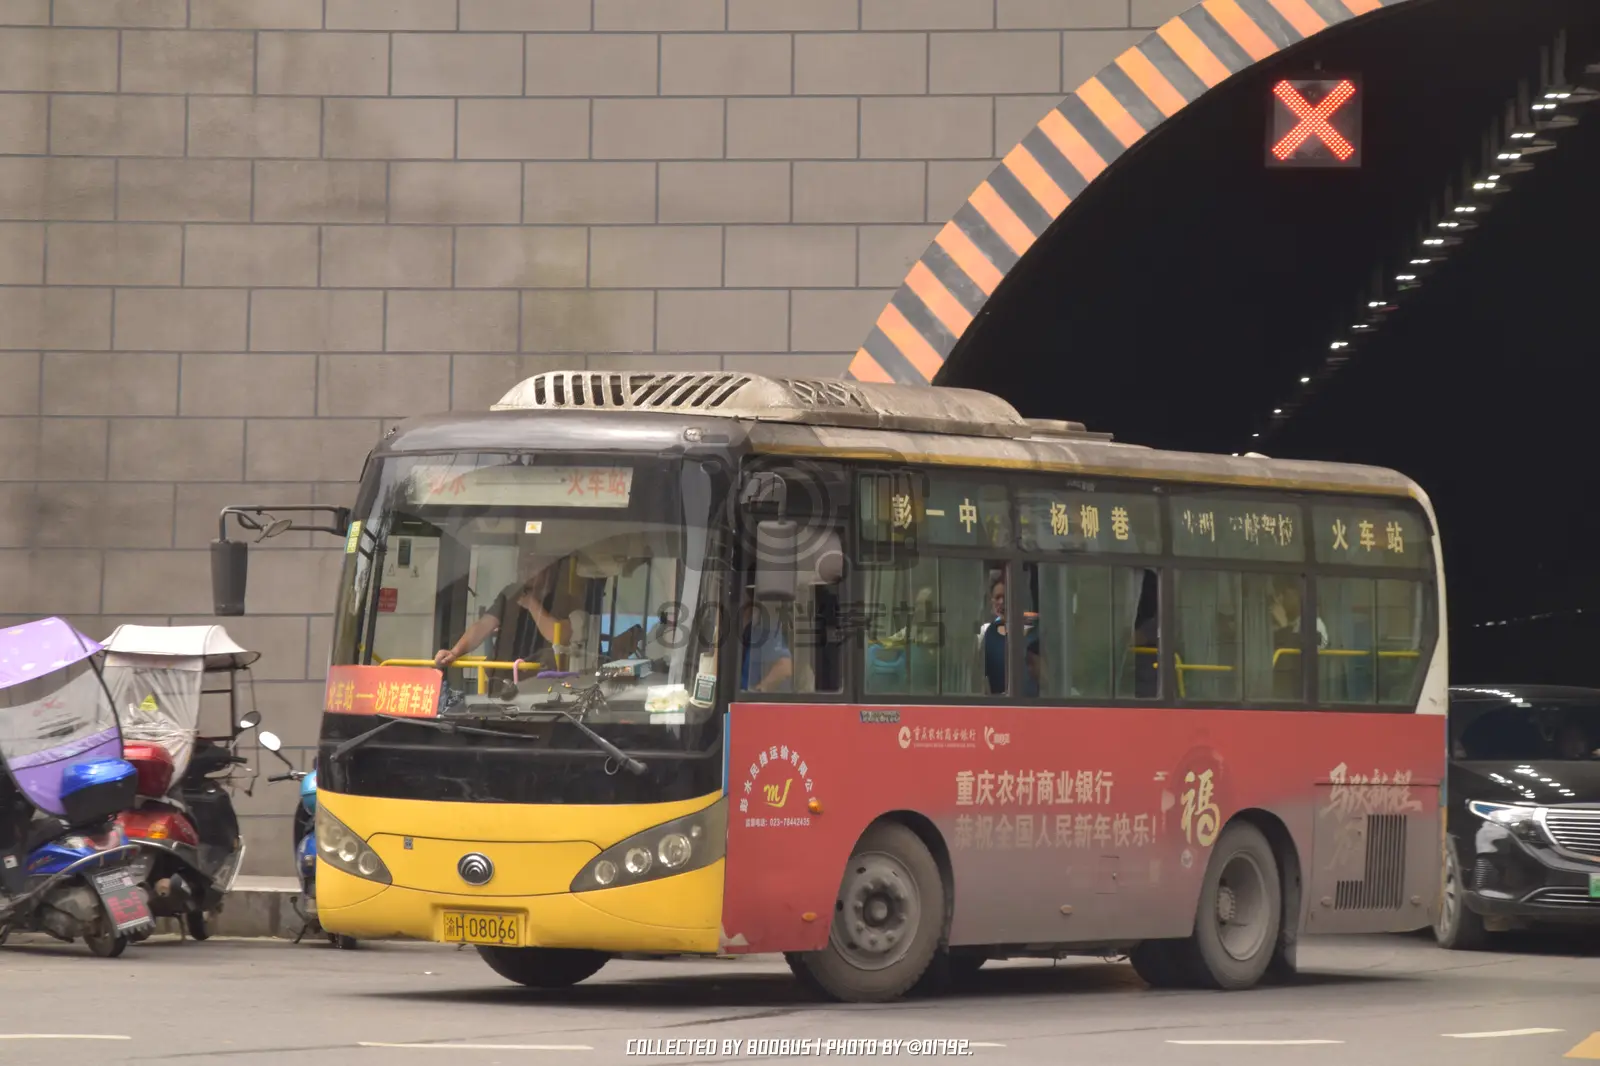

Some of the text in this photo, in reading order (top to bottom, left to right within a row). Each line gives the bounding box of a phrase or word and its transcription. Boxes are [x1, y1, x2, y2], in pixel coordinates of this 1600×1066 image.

[567, 471, 627, 496] 火车站
[892, 494, 977, 534] 彭一中
[1050, 501, 1129, 541] 杨柳巷
[1332, 519, 1404, 553] 火车站
[955, 769, 1114, 806] 重庆农村商业银行
[1180, 768, 1221, 846] 福
